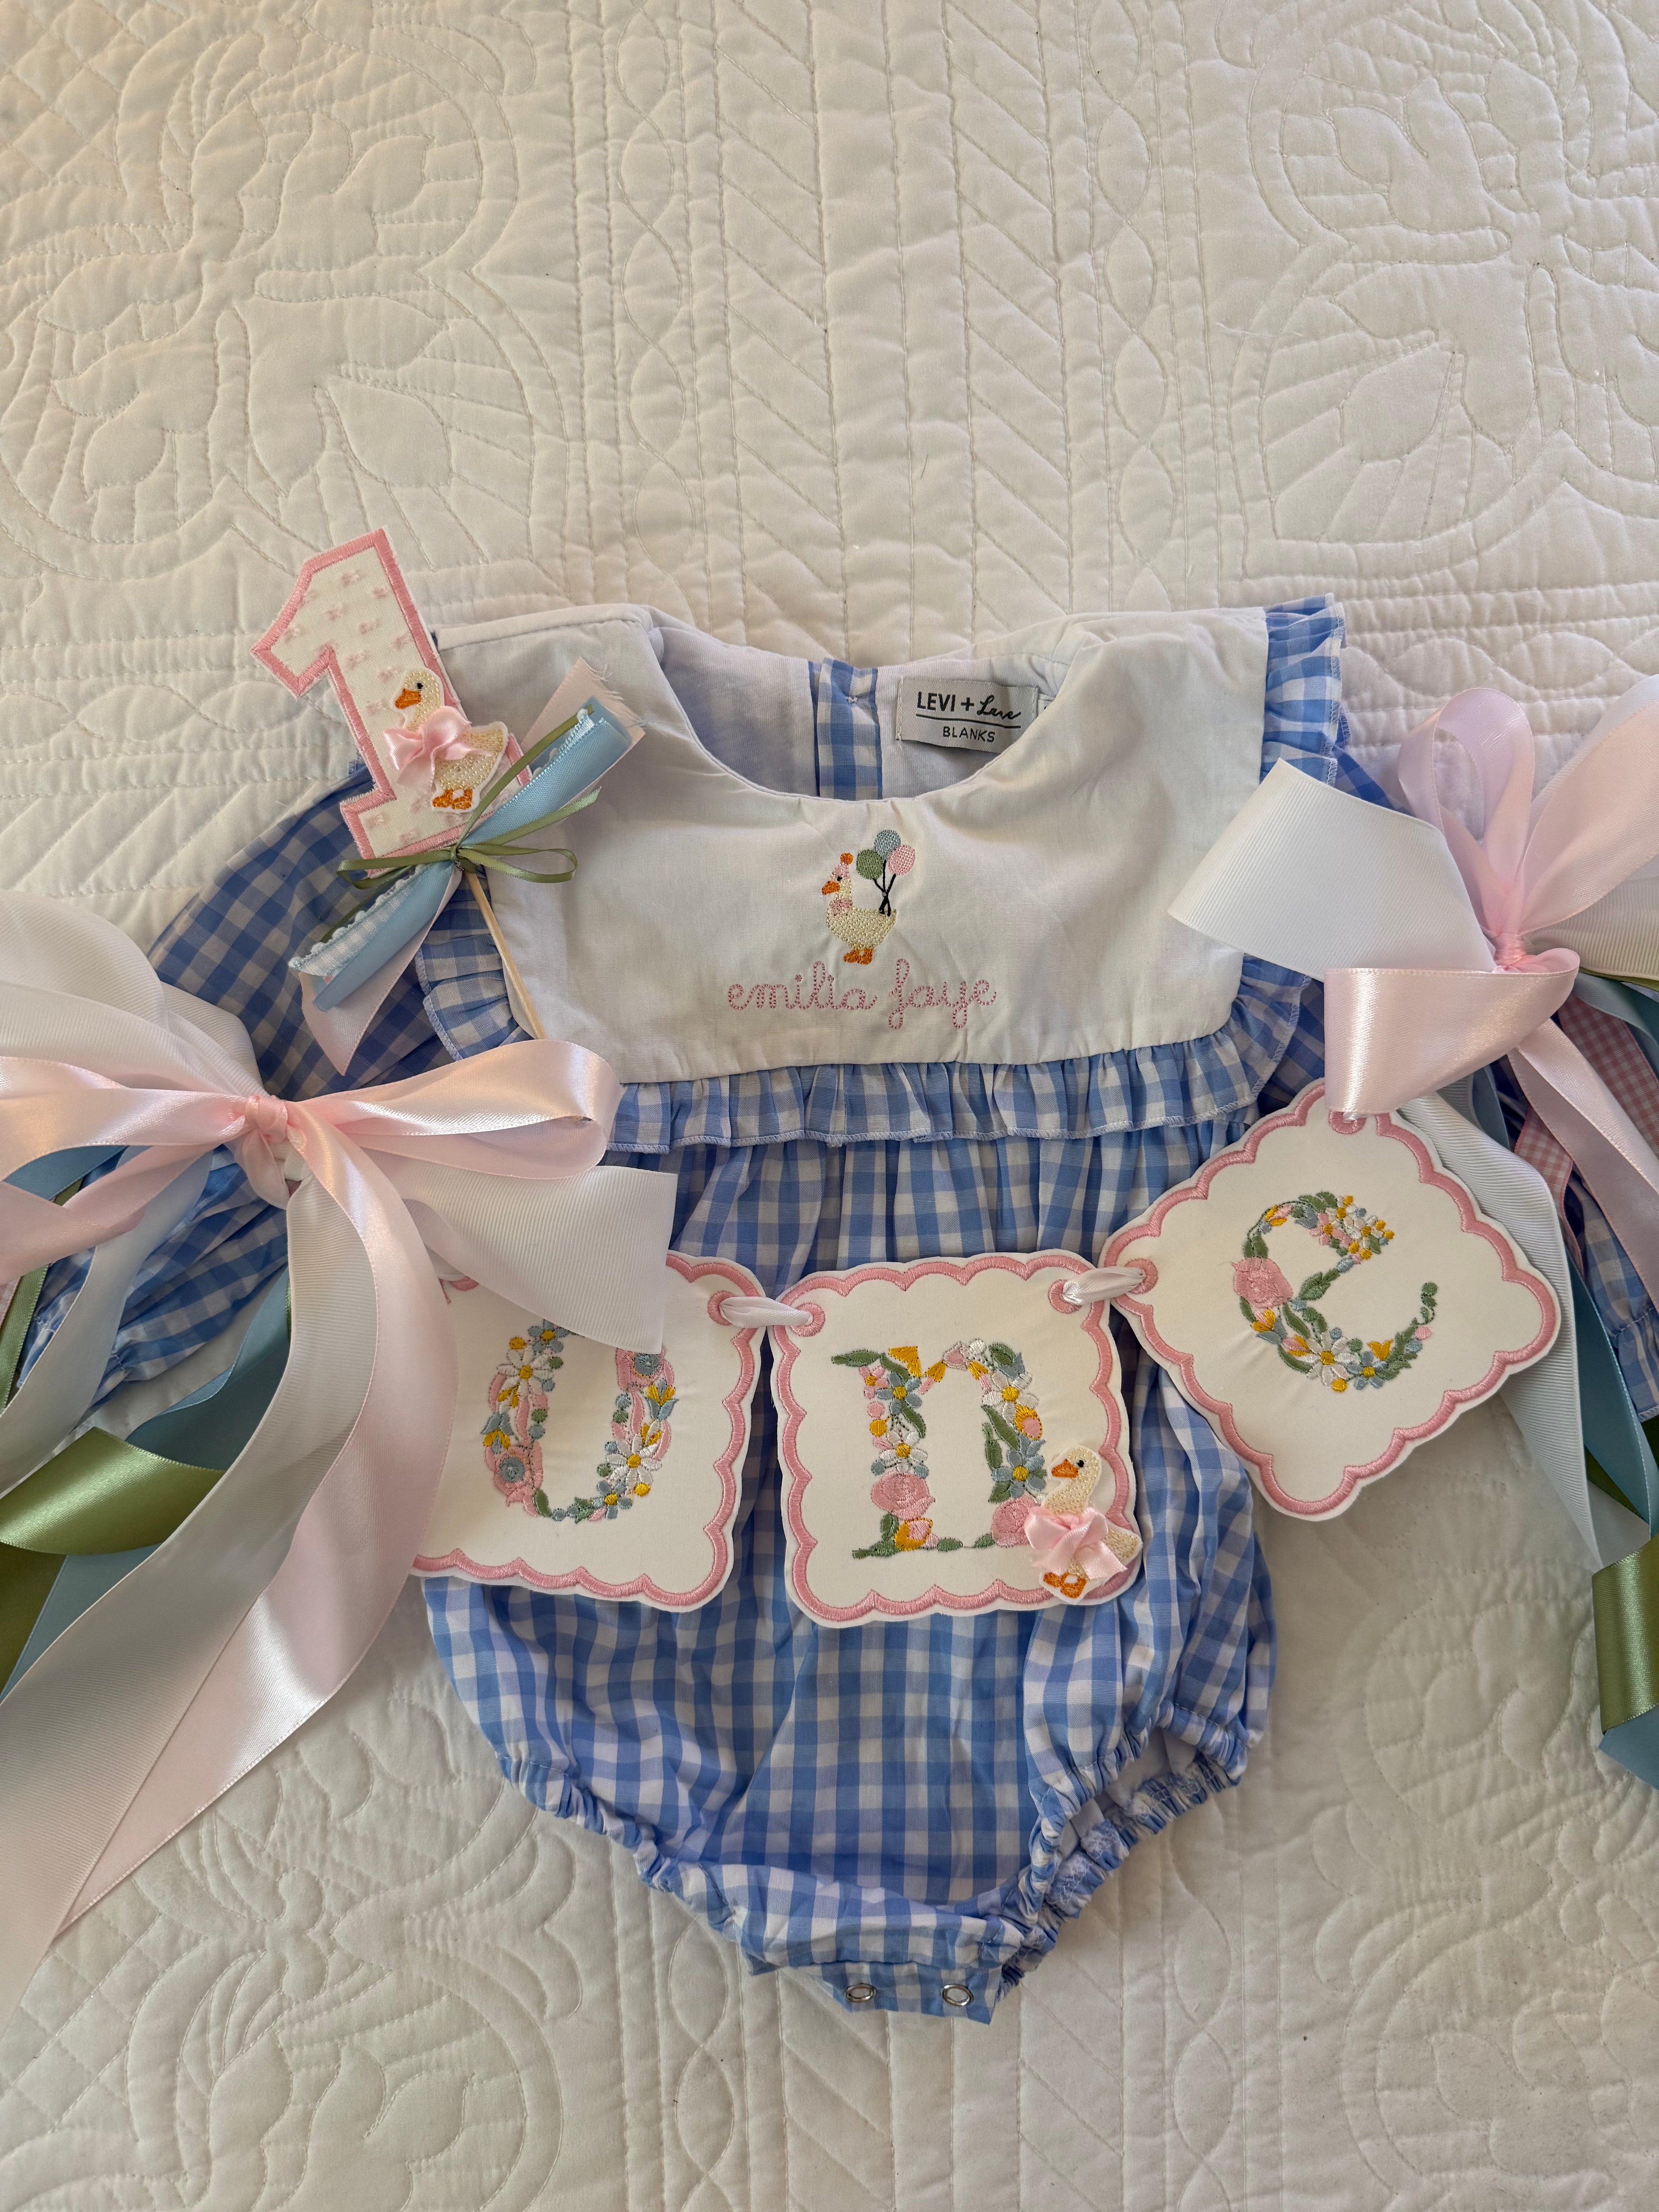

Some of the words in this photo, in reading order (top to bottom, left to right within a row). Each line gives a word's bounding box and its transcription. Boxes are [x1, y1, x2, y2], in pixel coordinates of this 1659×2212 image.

[250, 528, 533, 879] 1
[917, 691, 956, 712] LEVI
[960, 697, 975, 712] +
[942, 726, 996, 743] BLANKS
[727, 960, 878, 1011] emilia
[888, 958, 997, 1030] faye
